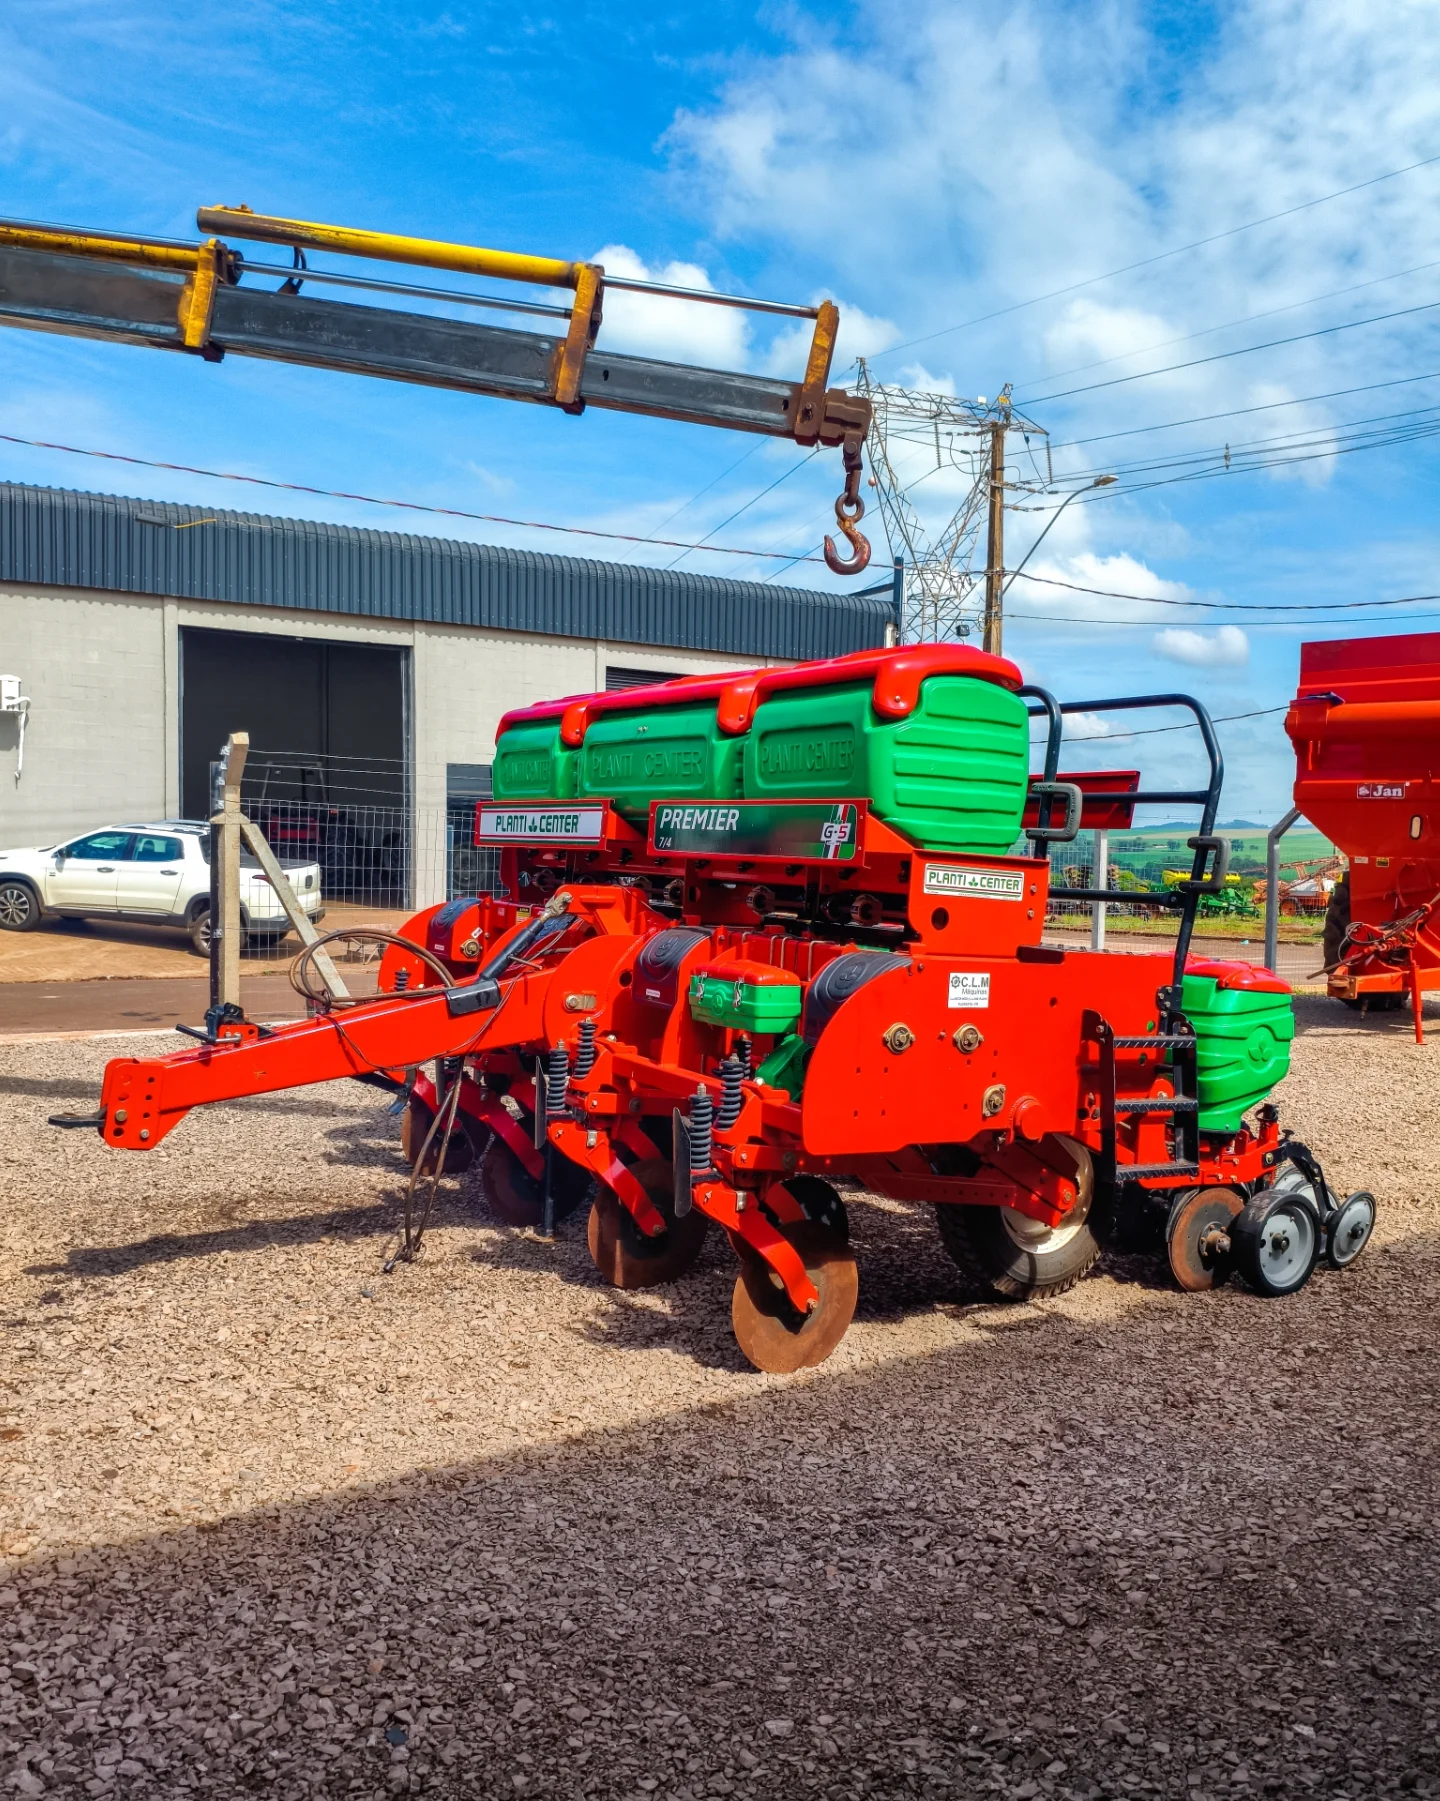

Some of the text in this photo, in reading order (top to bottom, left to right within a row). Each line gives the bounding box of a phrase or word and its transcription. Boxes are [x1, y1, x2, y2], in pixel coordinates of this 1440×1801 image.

[592, 750, 702, 778] PLANTI CENTER
[761, 740, 854, 774] PLANTI CENTER
[1373, 785, 1402, 797] Jan
[496, 814, 579, 833] PLANTI CENTER
[660, 808, 740, 831] PREMIER
[658, 836, 672, 848] 7/4
[928, 871, 1020, 891] PLANTI CENTER
[961, 976, 989, 988] C.L.M
